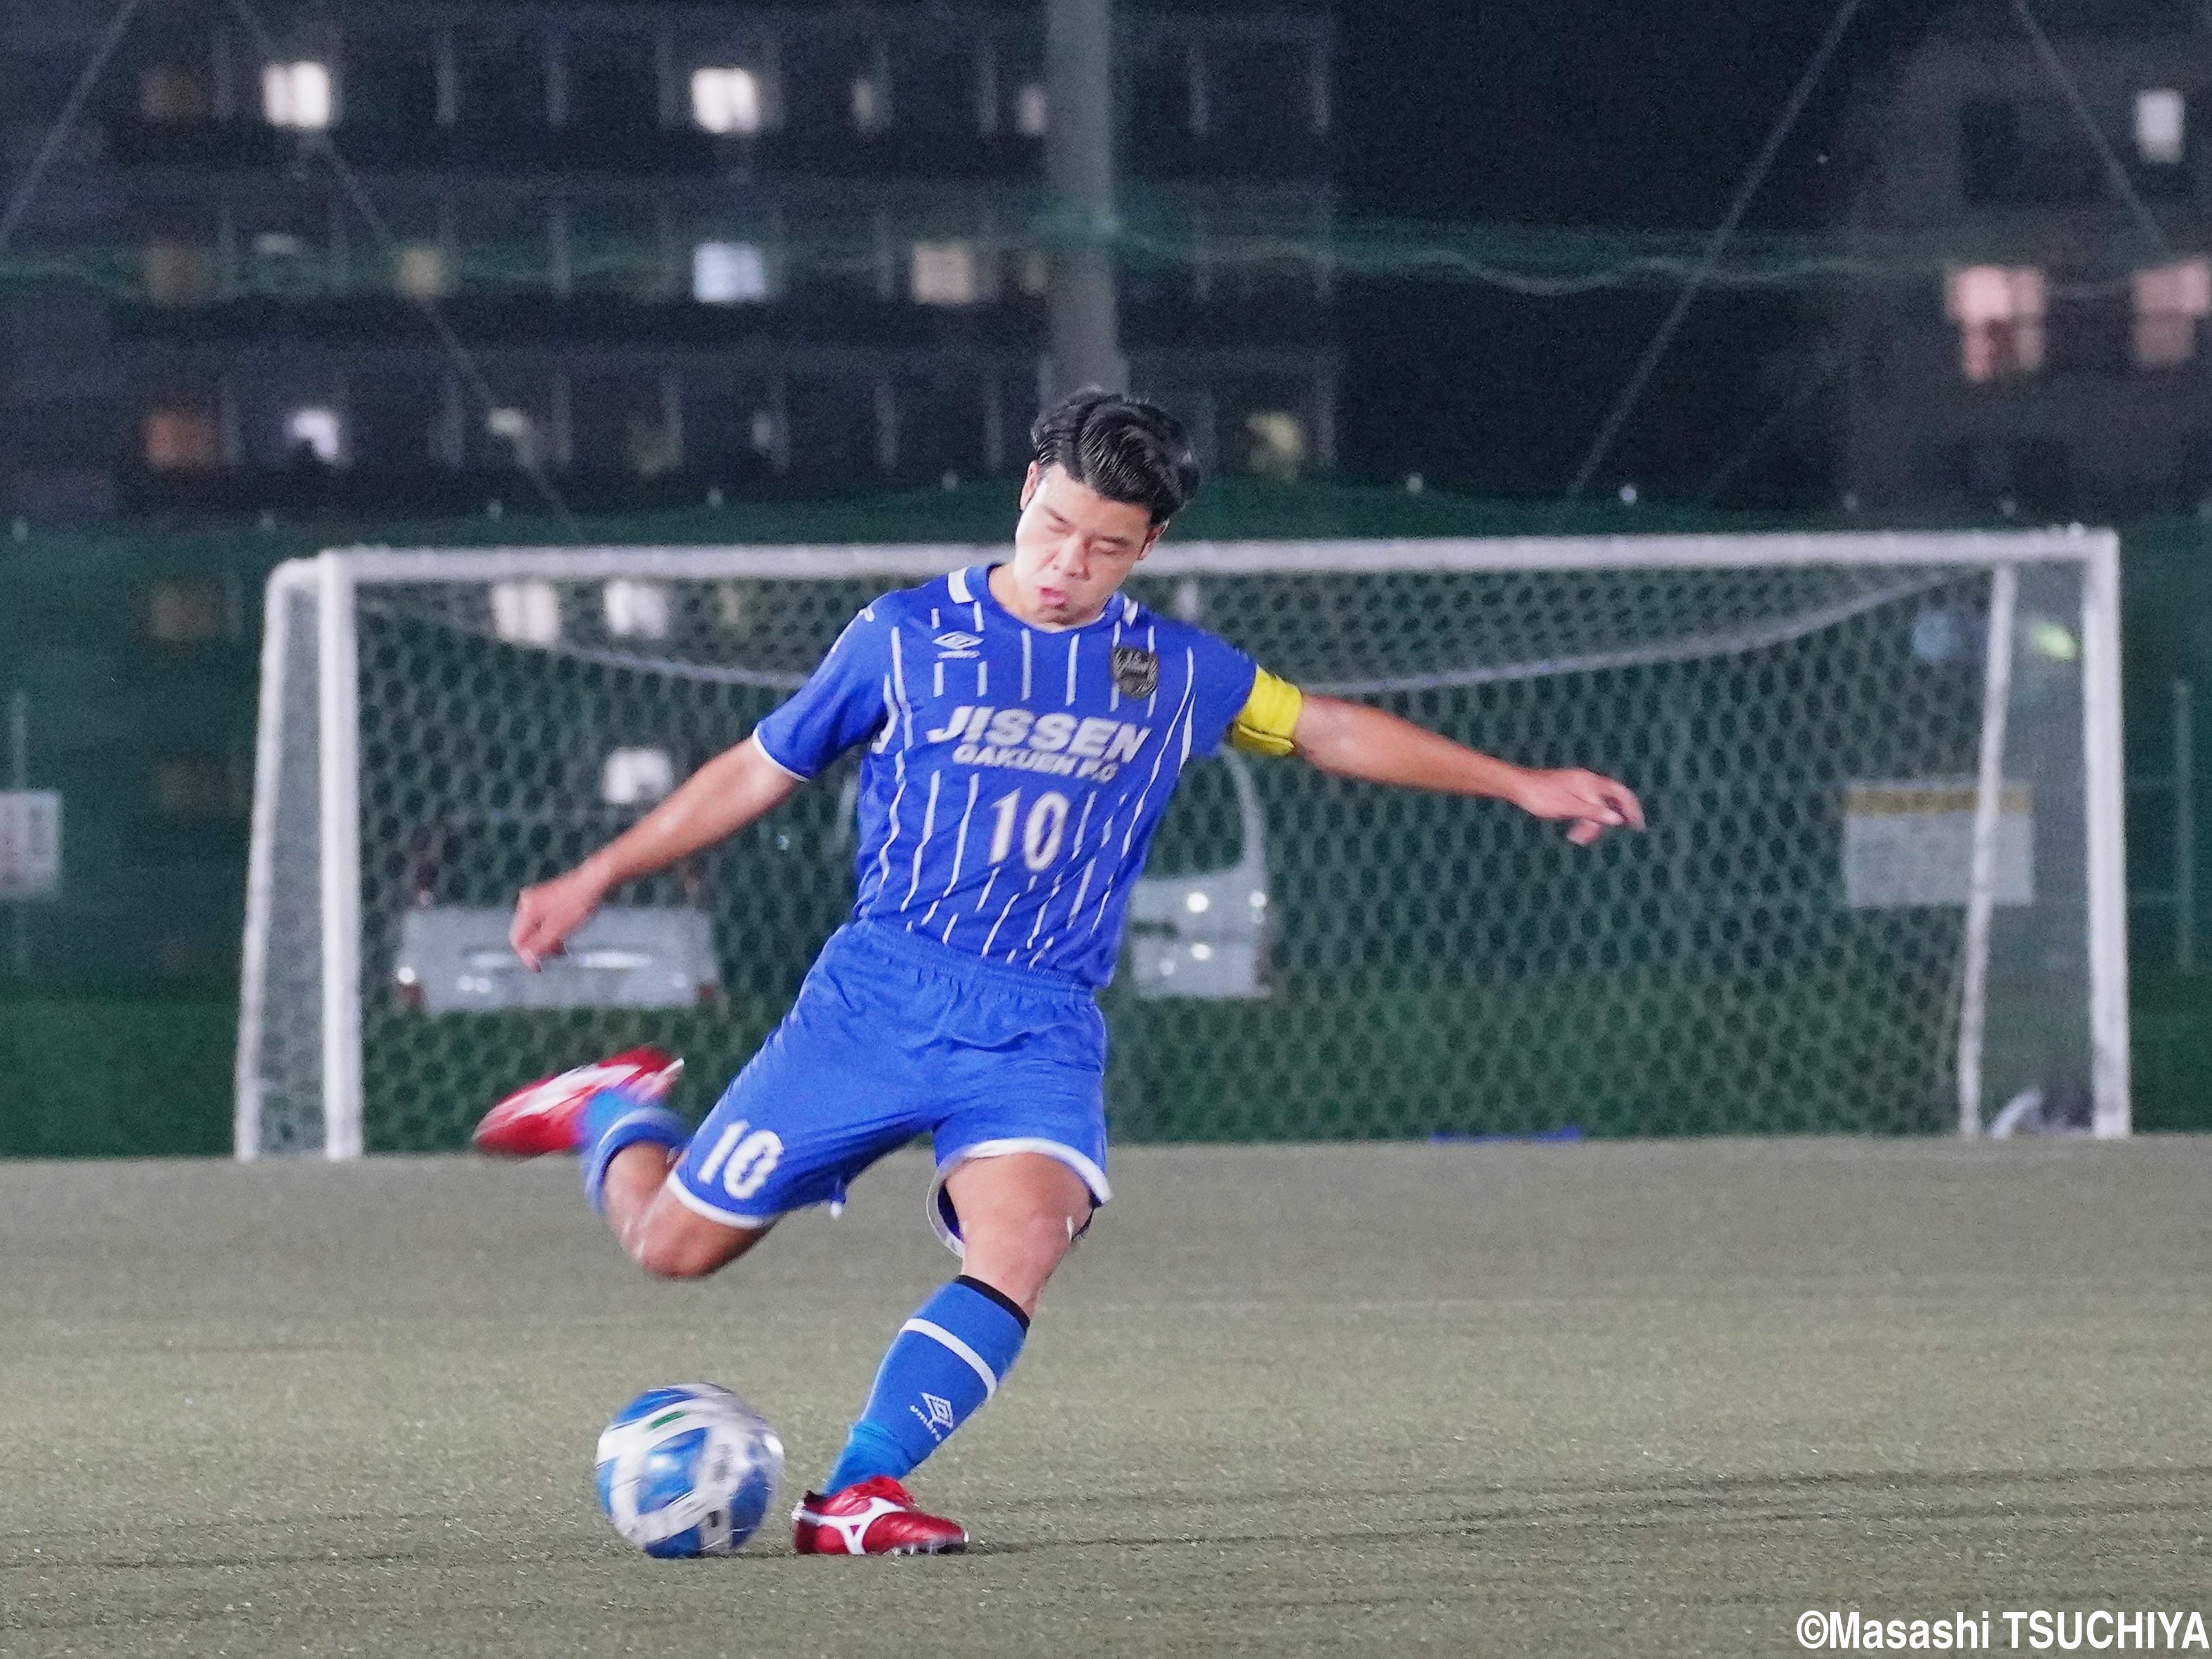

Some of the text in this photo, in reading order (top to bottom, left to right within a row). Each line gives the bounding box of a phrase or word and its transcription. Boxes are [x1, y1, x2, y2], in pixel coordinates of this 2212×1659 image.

[925, 705, 1152, 763] JISSEN
[989, 787, 1070, 871] 10
[697, 1119, 785, 1199] 10
